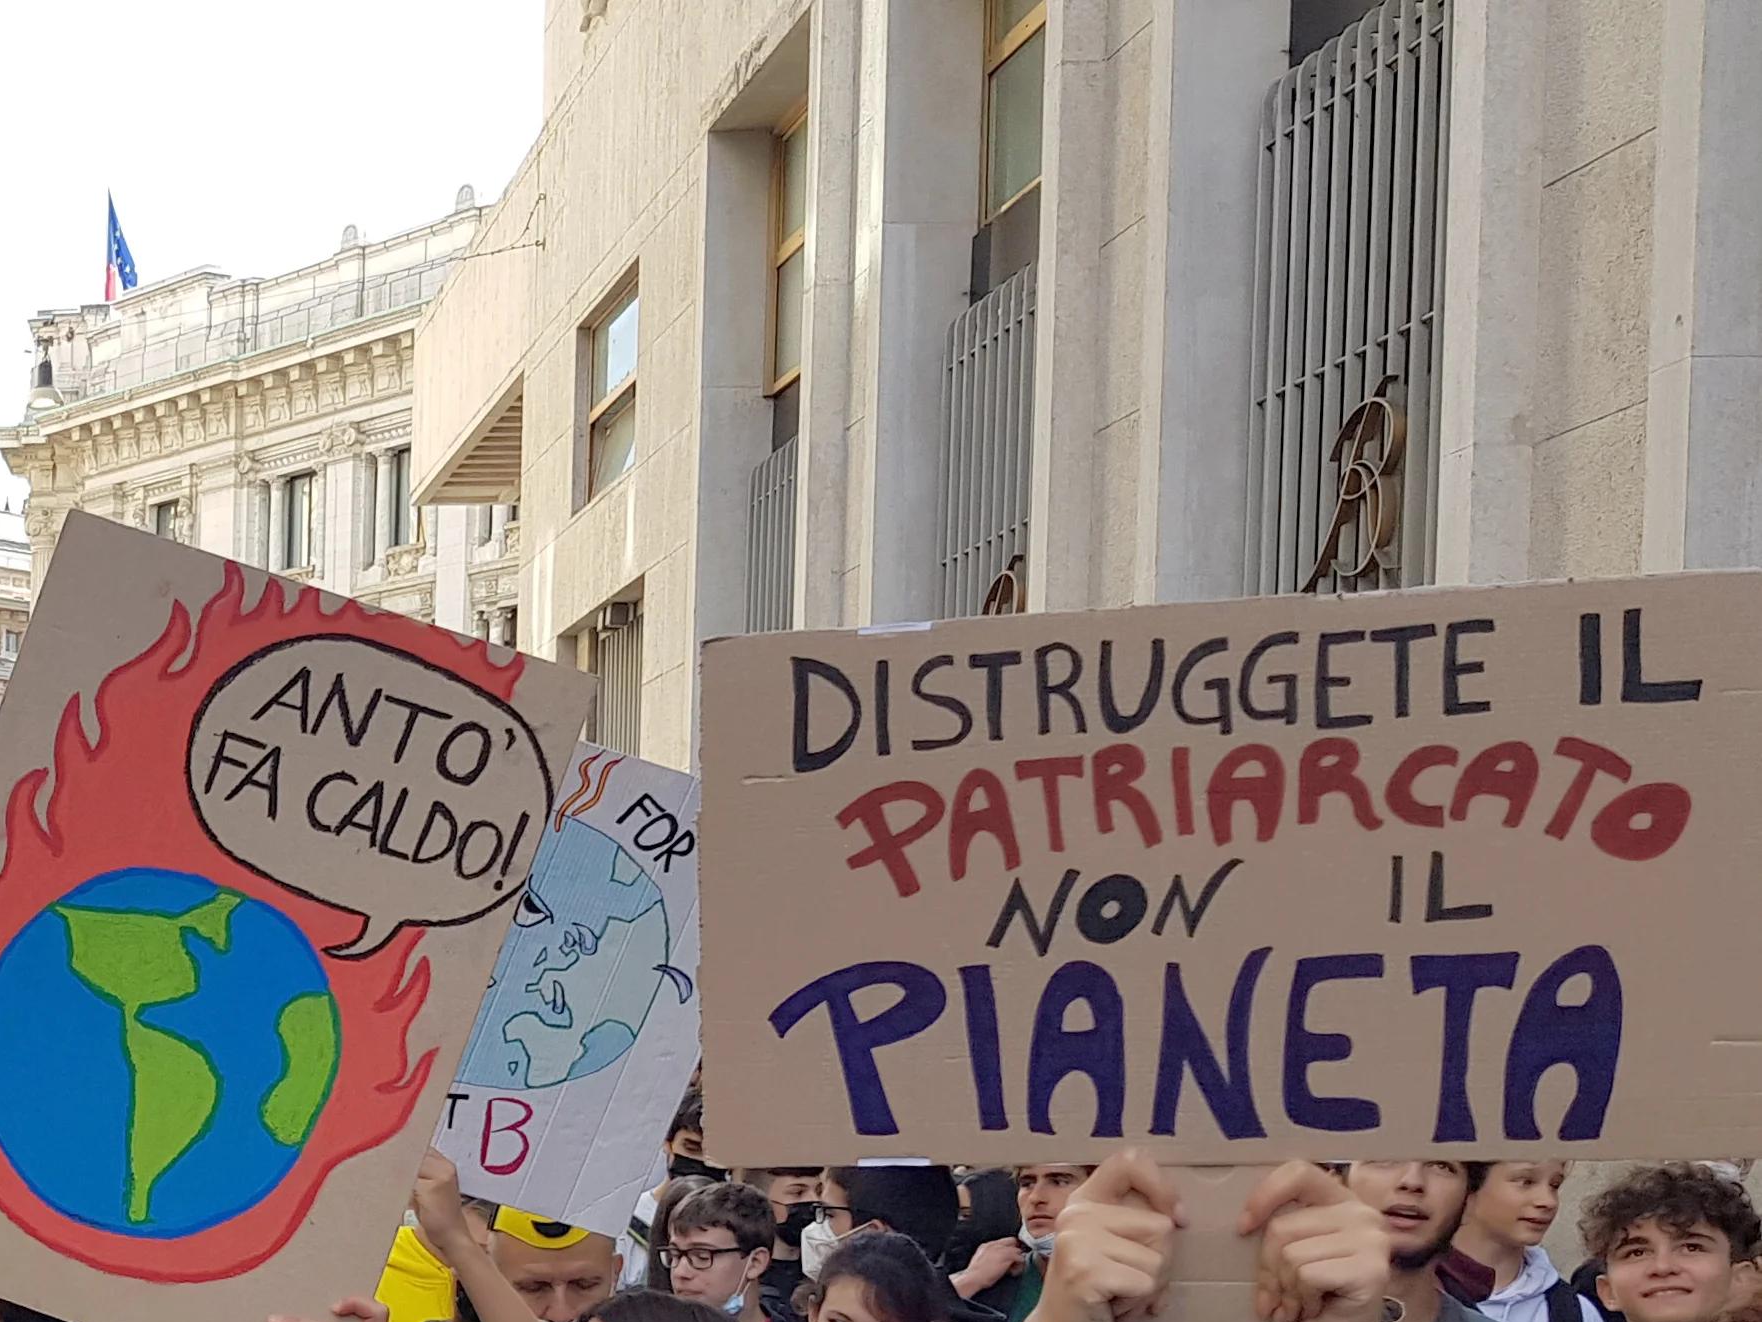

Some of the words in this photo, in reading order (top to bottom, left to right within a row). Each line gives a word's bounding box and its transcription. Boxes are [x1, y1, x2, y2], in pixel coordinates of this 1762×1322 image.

[790, 618, 1496, 773] DISTRUGGETE
[1577, 608, 1704, 706] IL
[204, 728, 283, 821] FA
[305, 770, 531, 892] CALDO!
[614, 792, 696, 874] FOR
[836, 735, 1693, 899] PATRIARCATO
[986, 857, 1245, 957] NON
[1388, 850, 1495, 925] IL
[767, 943, 1624, 1143] PIANETA
